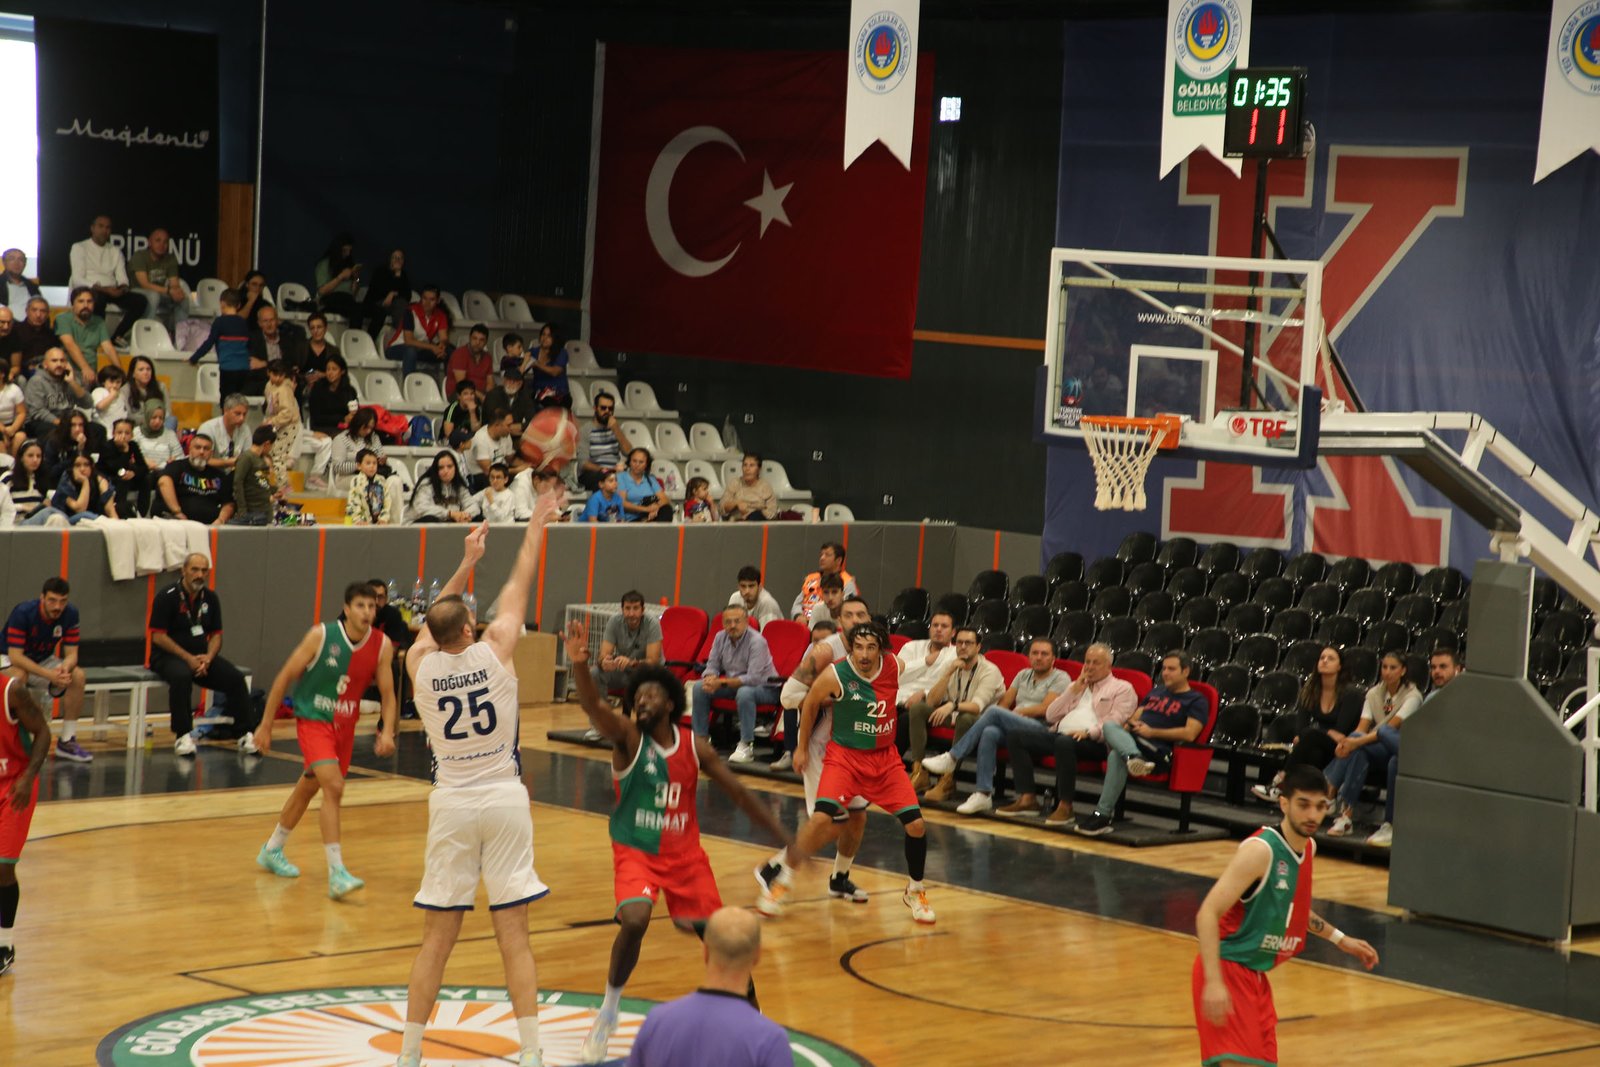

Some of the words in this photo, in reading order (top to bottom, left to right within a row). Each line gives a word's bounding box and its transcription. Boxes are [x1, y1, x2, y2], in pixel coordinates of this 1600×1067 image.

[1177, 81, 1227, 99] GÖLBAŞ
[1233, 77, 1292, 107] 01:35
[1176, 97, 1227, 113] BELEDİYES
[678, 382, 688, 392] E4
[744, 413, 754, 424] E3
[1249, 418, 1288, 440] TBF
[812, 450, 823, 461] E2
[883, 494, 893, 505] E1
[432, 669, 488, 692] DOĞUKAN
[313, 694, 357, 715] ERMAT
[438, 686, 497, 740] 25
[867, 700, 887, 718] 22
[854, 719, 895, 734] ERMAT
[655, 782, 682, 809] 30
[635, 808, 689, 832] ERMAT
[1285, 902, 1294, 929] 1
[1261, 934, 1302, 952] ERMAT
